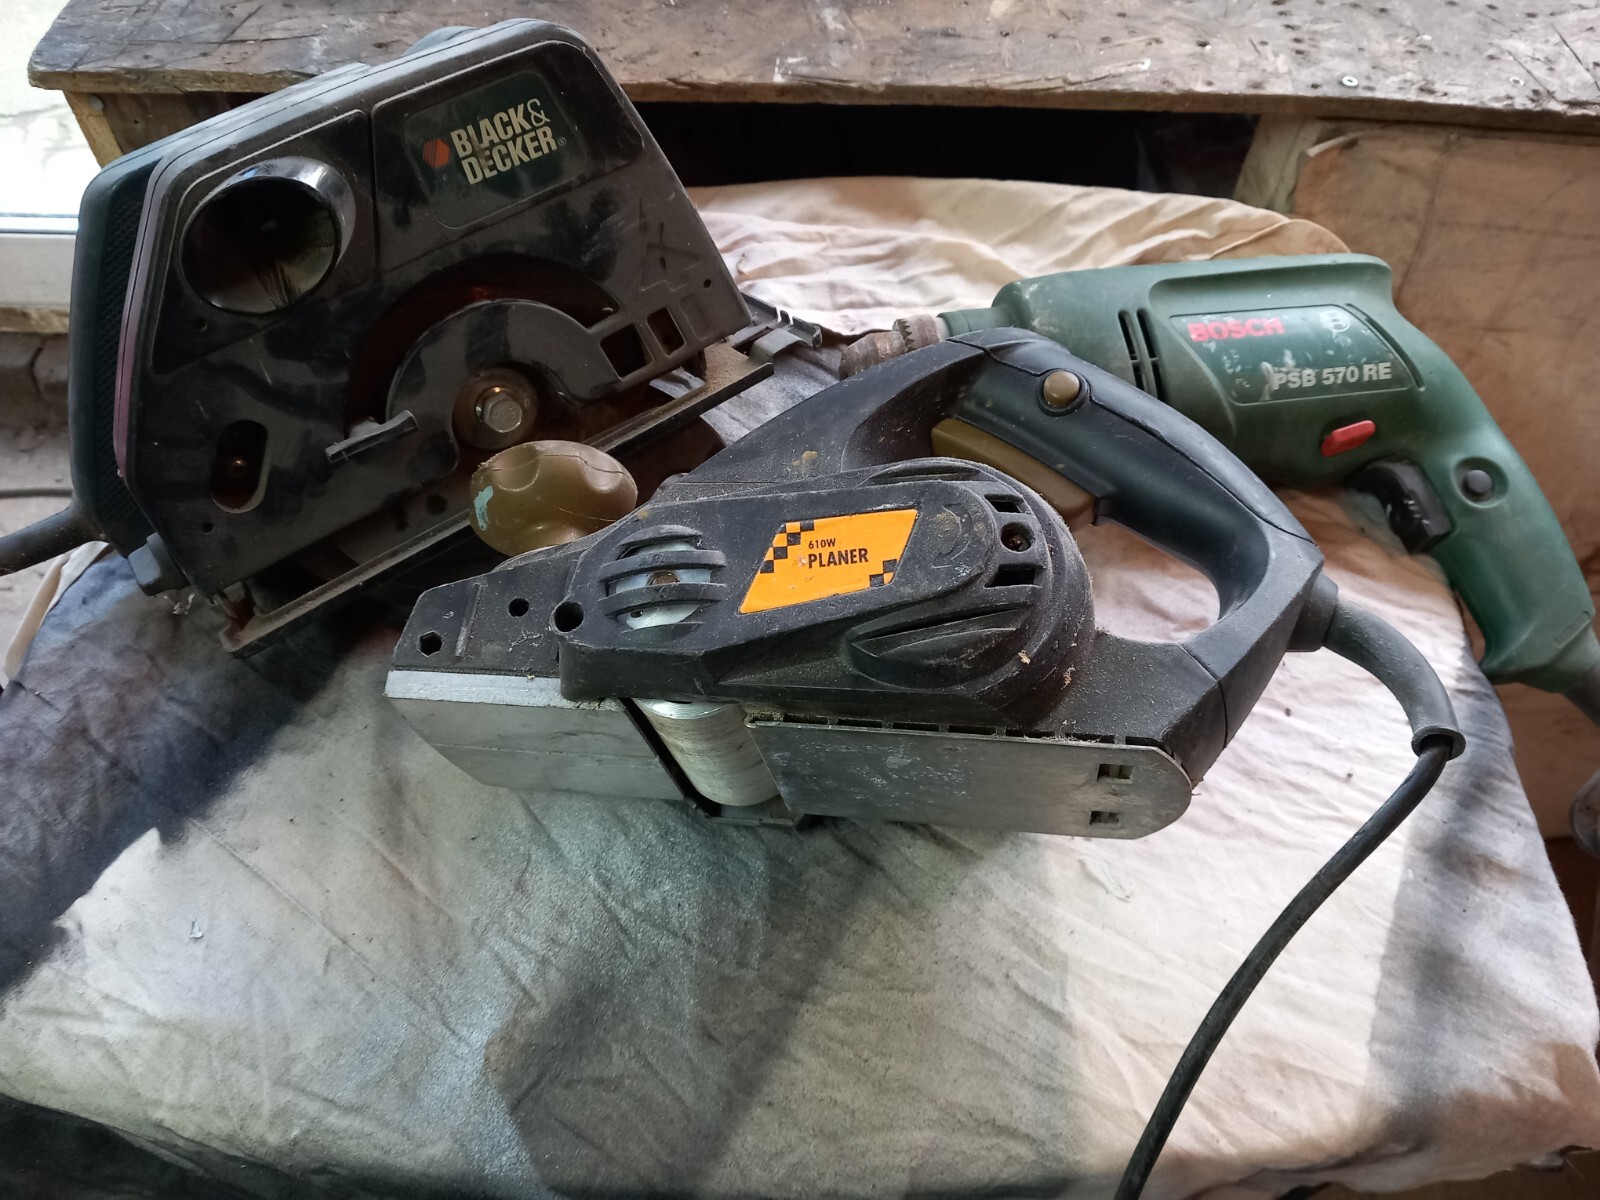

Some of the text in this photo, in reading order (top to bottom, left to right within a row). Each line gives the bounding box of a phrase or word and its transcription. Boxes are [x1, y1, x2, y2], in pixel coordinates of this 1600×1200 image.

[1187, 317, 1285, 342] BOSCH
[1272, 362, 1392, 391] PSB 570 RE
[808, 537, 836, 549] 610W
[808, 547, 869, 569] PLANER
